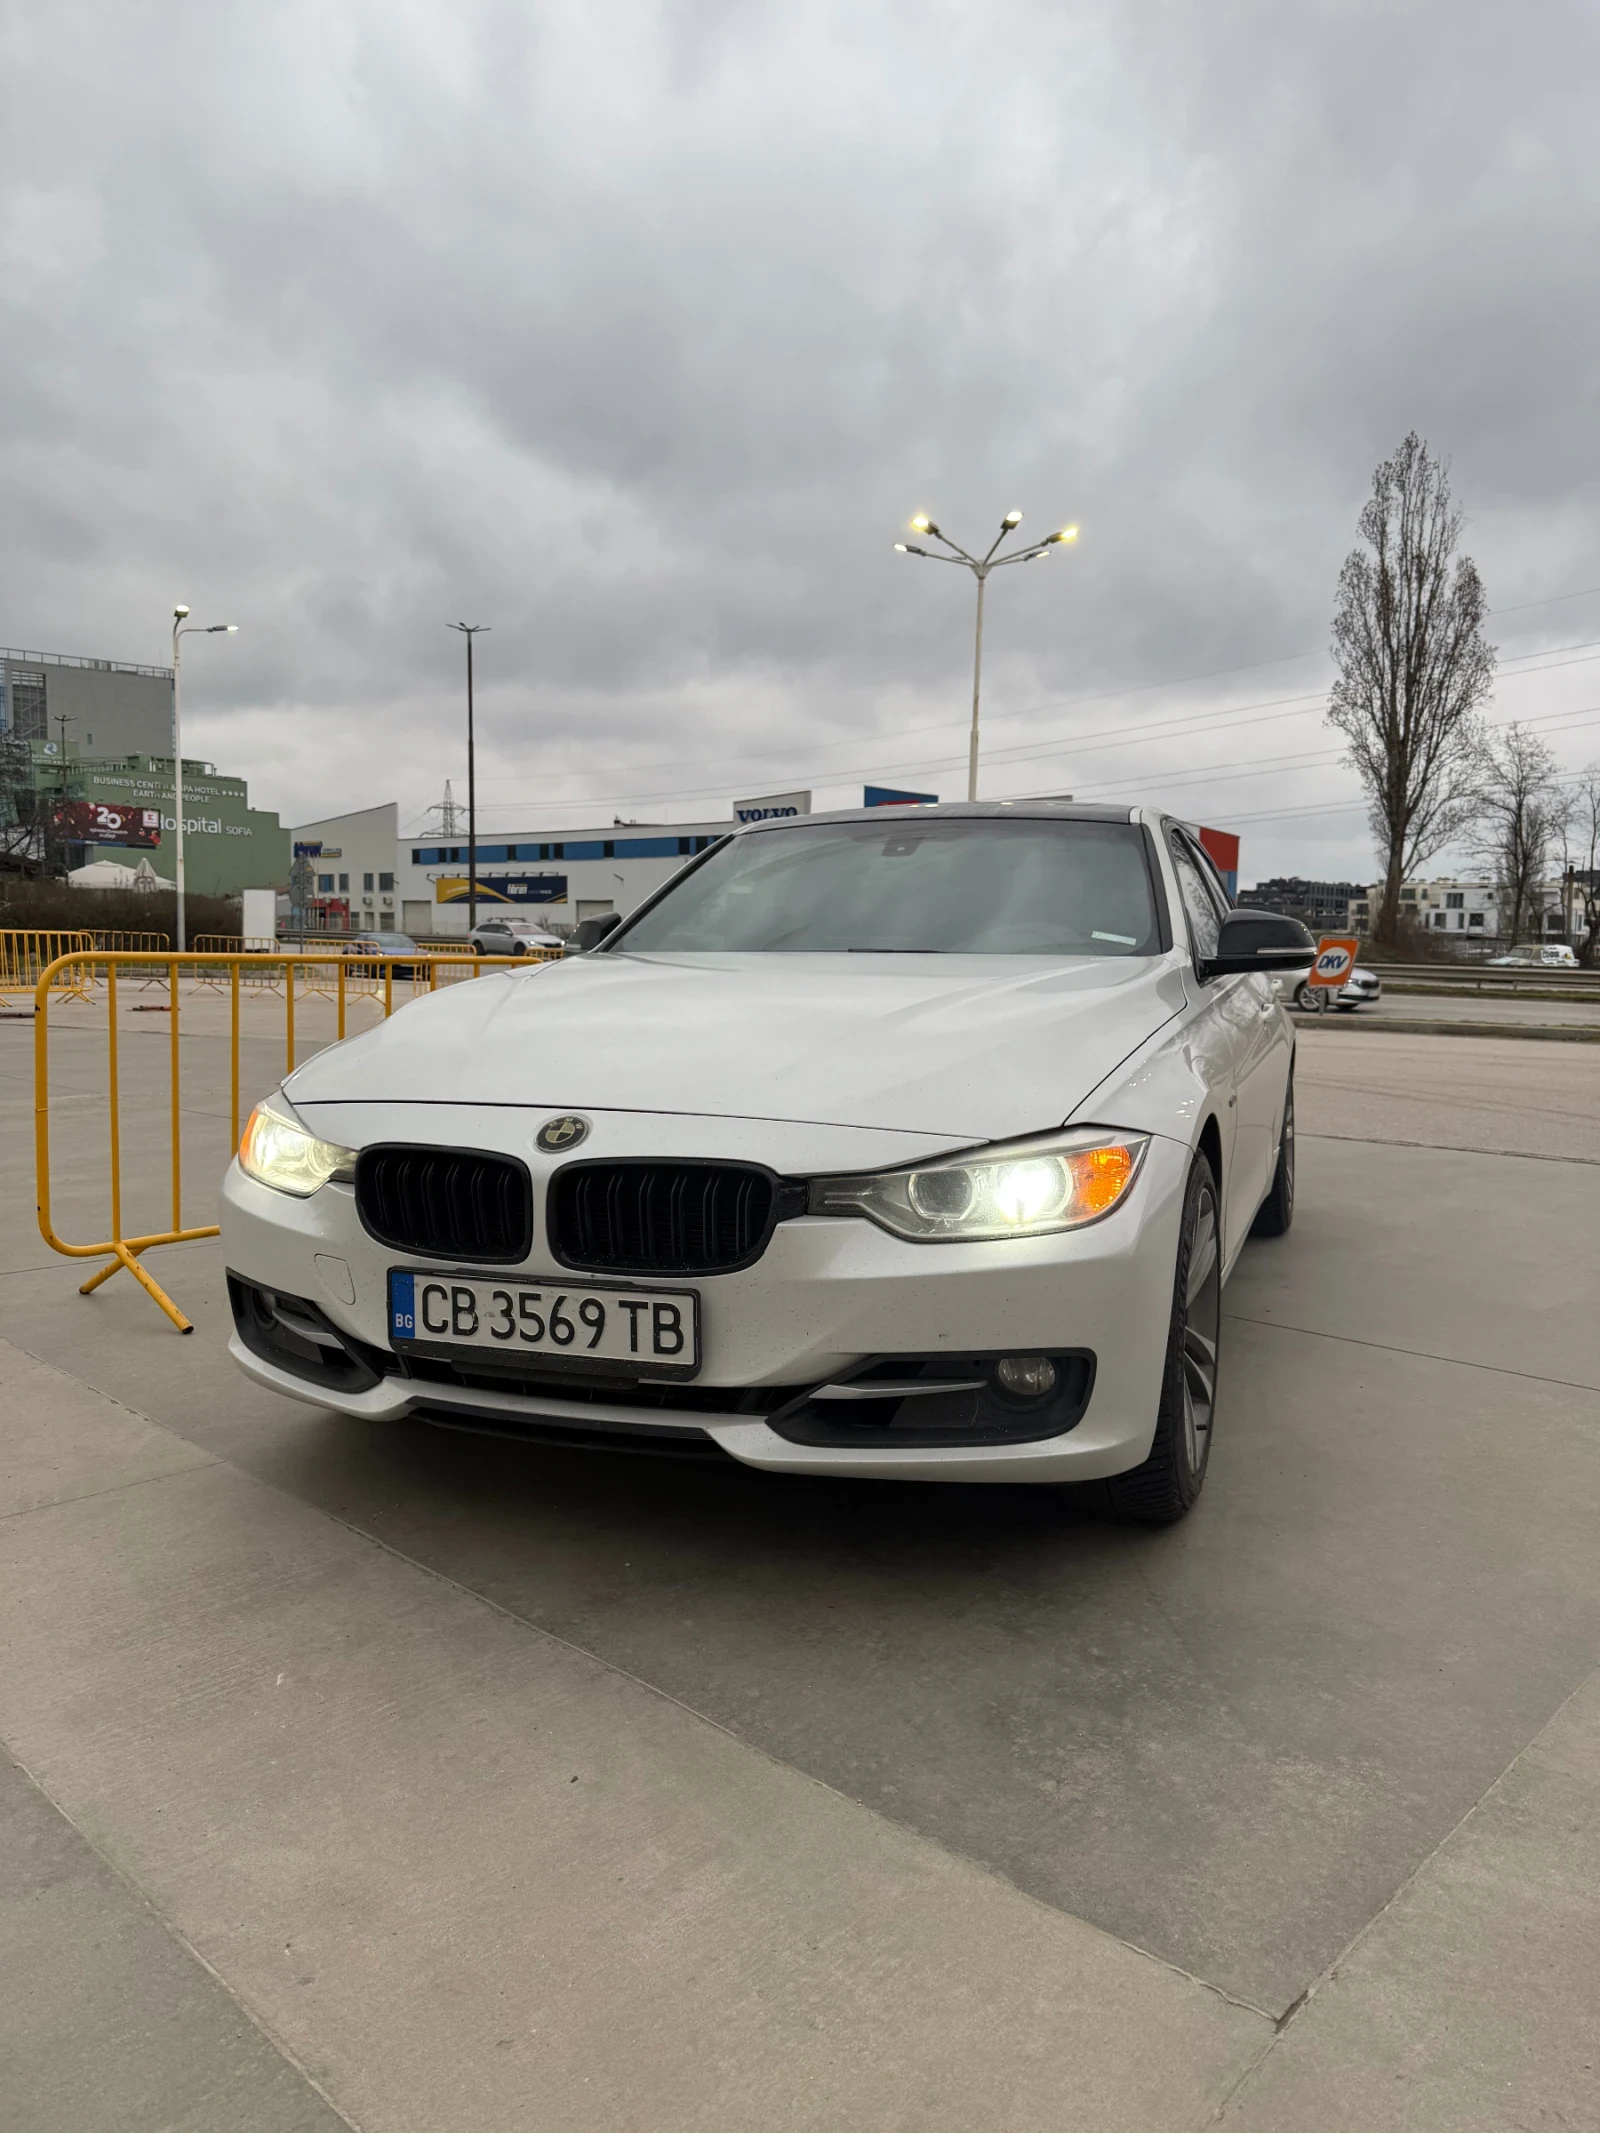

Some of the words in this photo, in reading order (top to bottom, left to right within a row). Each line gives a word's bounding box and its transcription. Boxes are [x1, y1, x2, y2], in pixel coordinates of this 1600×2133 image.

[93, 776, 135, 788] BUSINESS
[194, 786, 220, 796] HOTEL
[181, 793, 211, 803] PEOPLE
[97, 806, 121, 829] 20
[736, 807, 798, 822] VOLVO
[226, 826, 253, 836] SOFIA
[1317, 955, 1349, 969] DKV
[394, 1312, 413, 1329] BG
[421, 1283, 479, 1337] CB
[490, 1289, 606, 1349] 3569
[618, 1299, 684, 1356] TB
